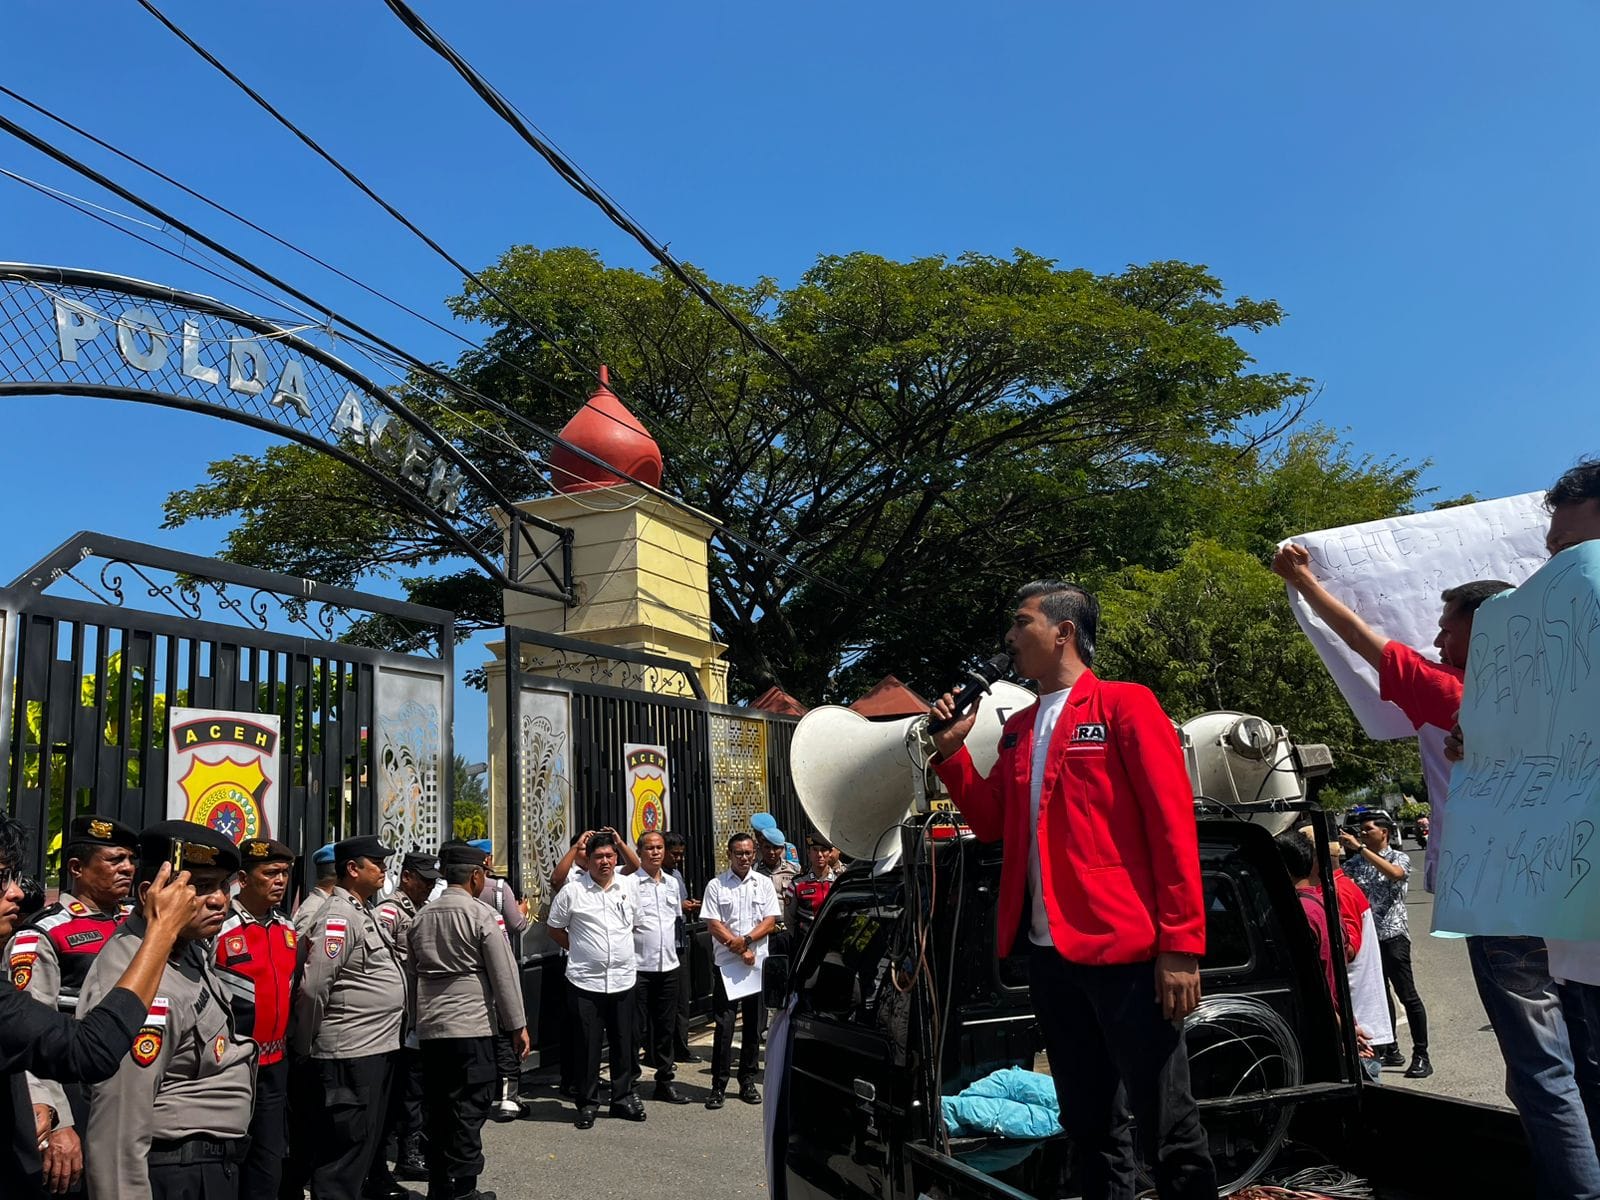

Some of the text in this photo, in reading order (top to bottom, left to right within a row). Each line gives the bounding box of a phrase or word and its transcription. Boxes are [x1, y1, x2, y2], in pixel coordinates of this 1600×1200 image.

[52, 297, 465, 513] POLDA ACEH
[186, 725, 267, 747] ACEH
[632, 753, 664, 767] ACEH
